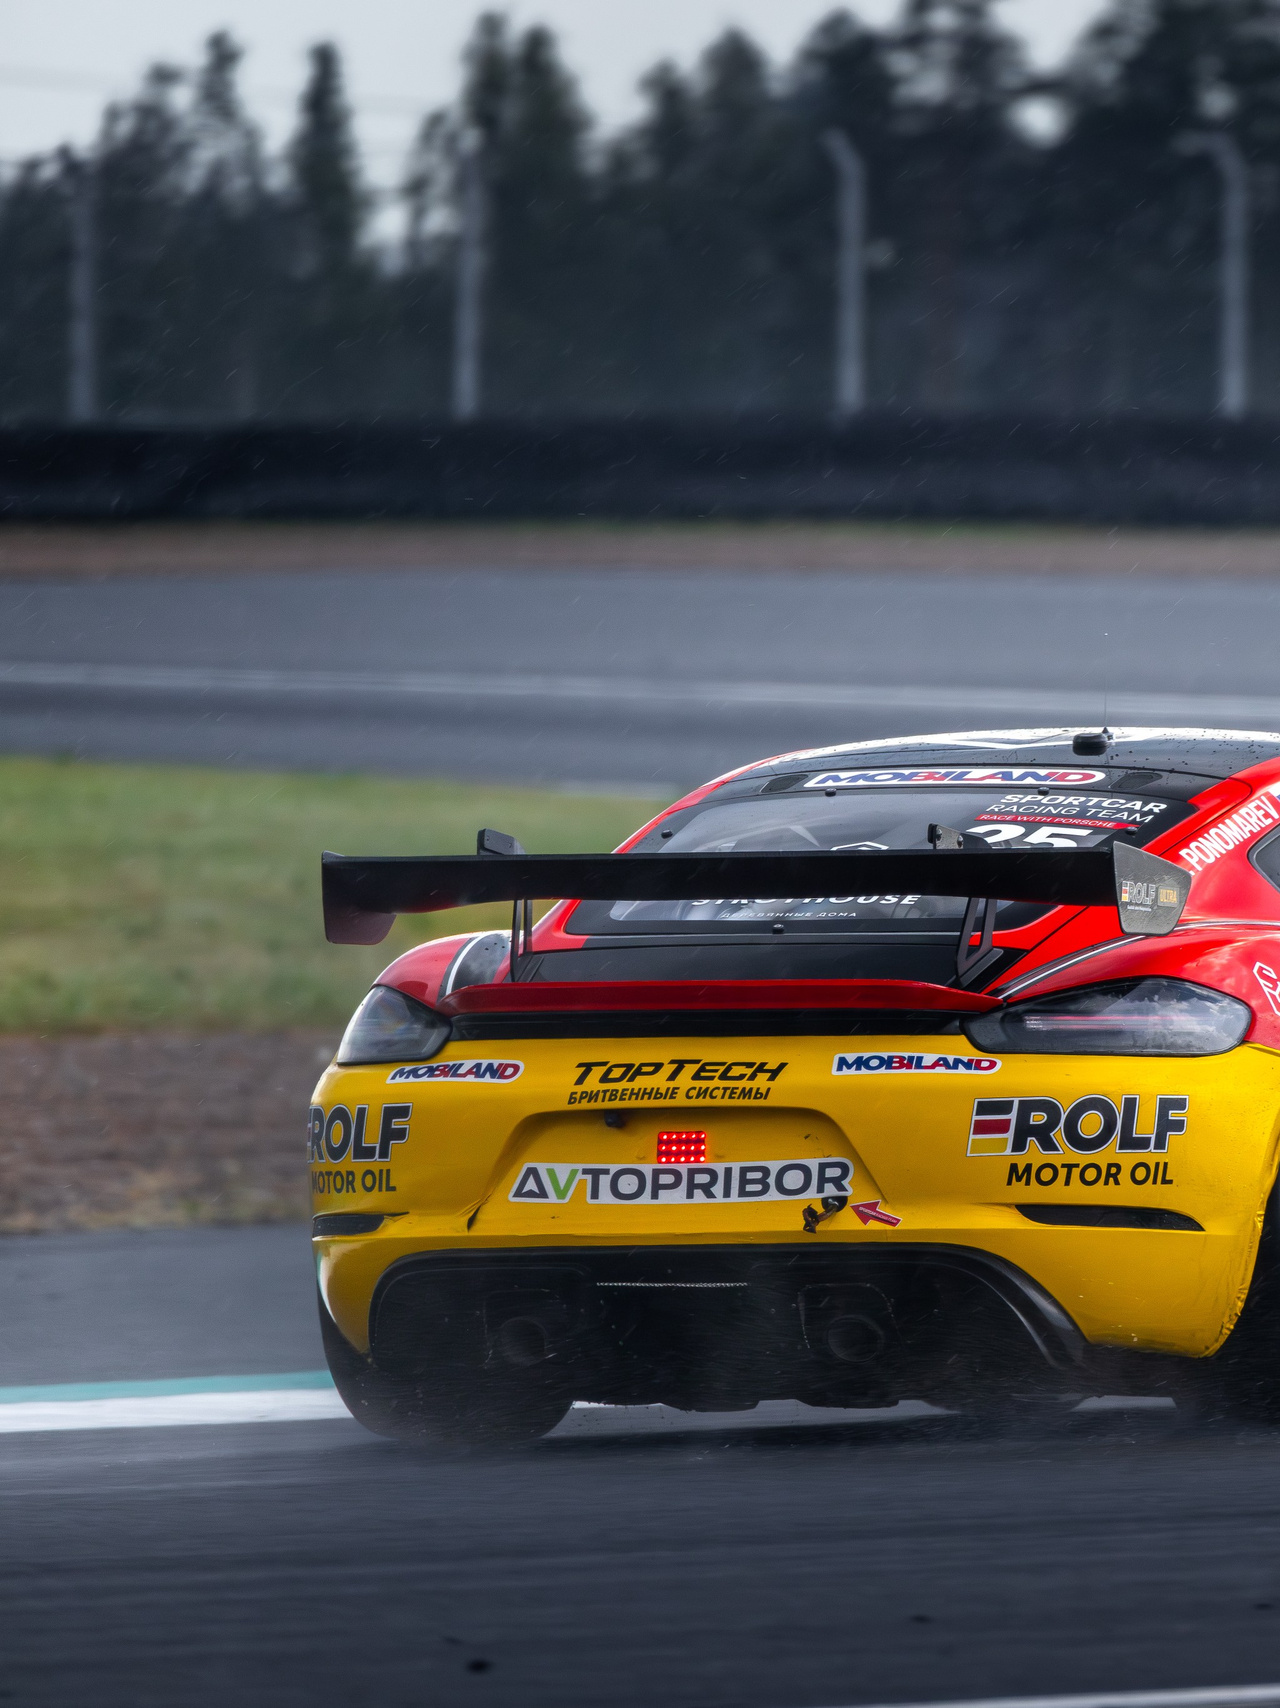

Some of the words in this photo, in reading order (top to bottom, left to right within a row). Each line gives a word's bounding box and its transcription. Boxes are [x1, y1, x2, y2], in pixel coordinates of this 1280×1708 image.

[813, 770, 1096, 784] MOBILAND
[1000, 794, 1167, 813] SPORTCAR
[980, 814, 1017, 822] RACE
[1054, 817, 1116, 828] PORSCHE
[986, 805, 1081, 816] RACING
[1086, 808, 1154, 823] TEAM
[1179, 796, 1280, 872] PONOMAREV
[390, 1063, 519, 1081] MOBILAND
[836, 1054, 998, 1073] MOBILAND
[568, 1086, 681, 1105] БРИТВЕННЫЕ
[684, 1086, 770, 1101] СИСТЕМЫ
[310, 1103, 412, 1162] ROLF
[1011, 1094, 1189, 1155] ROLF
[312, 1170, 356, 1194] MOTOR
[361, 1168, 397, 1193] OIL
[513, 1161, 849, 1201] AVTOPRIBOR
[1006, 1162, 1121, 1187] MOTOR
[1129, 1161, 1173, 1186] OIL
